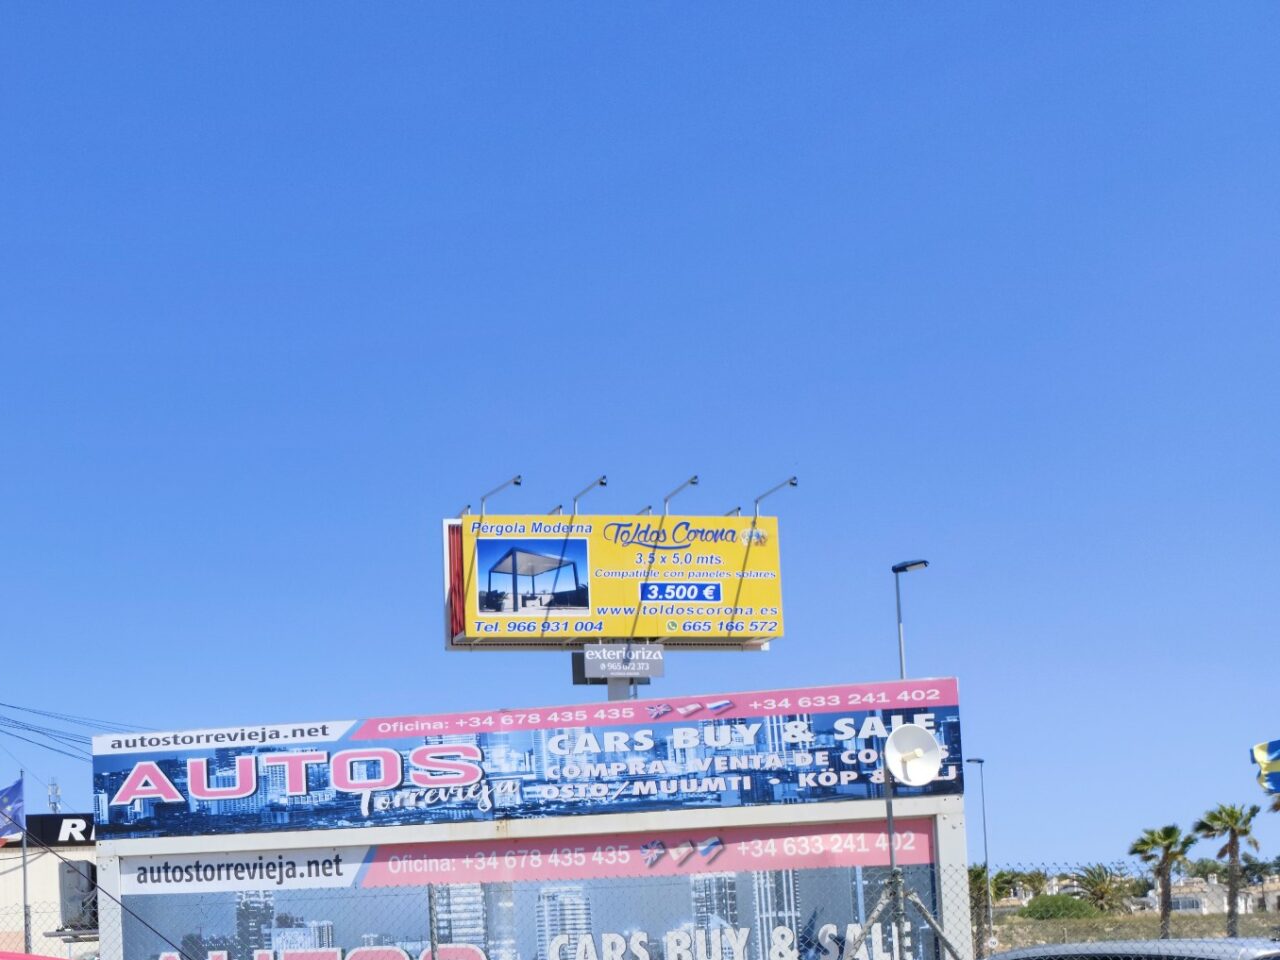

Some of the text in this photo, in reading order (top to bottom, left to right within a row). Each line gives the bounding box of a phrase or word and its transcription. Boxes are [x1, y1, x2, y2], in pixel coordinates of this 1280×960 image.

[471, 522, 593, 535] Pérgola Moderna
[603, 521, 737, 549] Toldos Corona
[660, 555, 667, 564] x
[595, 568, 776, 579] Compatible con paneles solares
[647, 585, 716, 600] 3.500 €
[597, 604, 778, 616] www.toldoscorona.es
[475, 621, 604, 633] Tel. 966 931 004
[682, 621, 778, 632] 665 166 572
[585, 647, 664, 660] exterioriza
[377, 688, 941, 734] Oficina: +34 678 435 435 +34 633 241 402
[111, 724, 330, 750] autostorrevieja.net
[548, 729, 655, 756] CARS
[672, 723, 763, 749] BUY
[782, 721, 815, 744] &
[110, 742, 485, 806] AUTOS
[546, 760, 667, 779] COMPRA
[693, 753, 783, 772] VENTA
[794, 750, 830, 766] DE
[542, 776, 751, 800] OSTO/MUUMTI
[798, 768, 859, 787] KÖP
[358, 778, 522, 817] Torrevieja
[58, 818, 95, 842] R
[387, 830, 916, 874] Oficina: +34 678 435 435 +34 633 241 402
[136, 854, 344, 886] autostorrevieja.net
